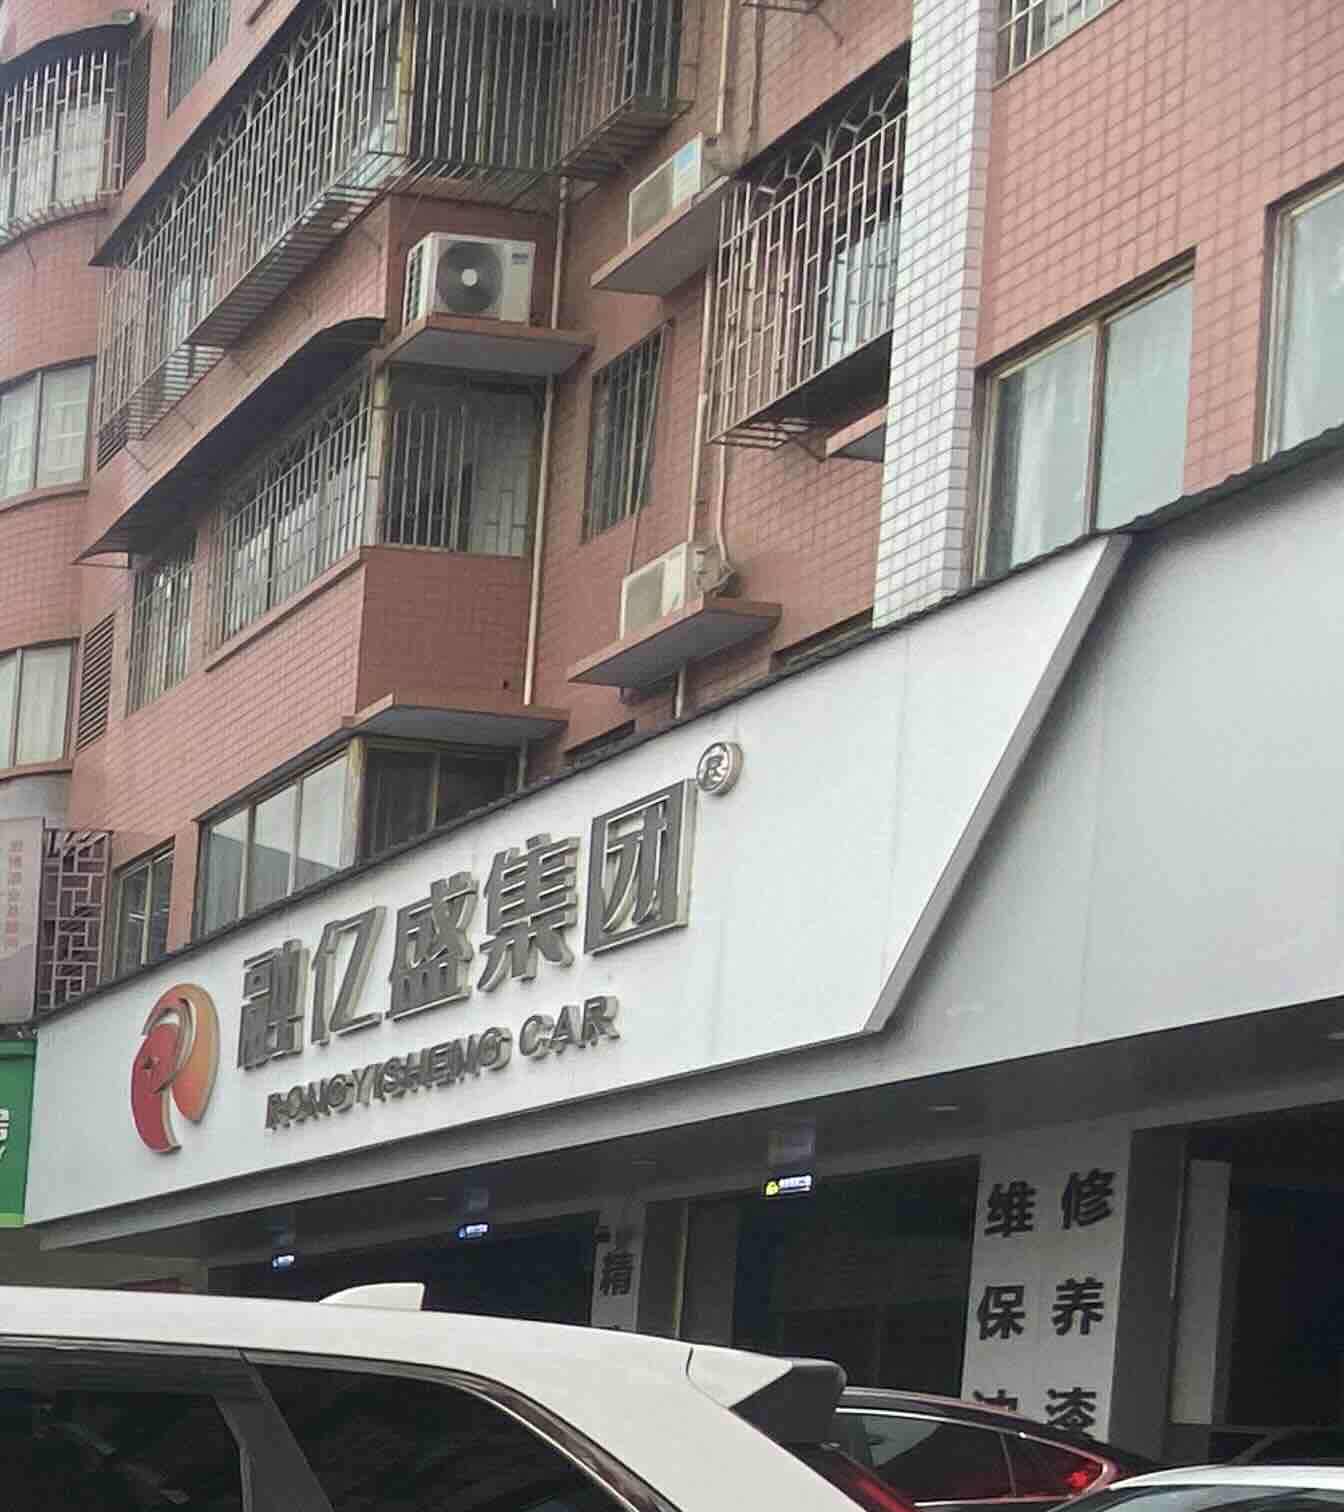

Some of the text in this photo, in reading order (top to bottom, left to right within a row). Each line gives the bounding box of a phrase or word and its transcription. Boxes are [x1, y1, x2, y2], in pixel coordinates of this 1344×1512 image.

[237, 778, 698, 1071] 融亿盛集团
[265, 995, 621, 1130] RONGYISHENG CAR
[984, 1168, 1116, 1238] 维修
[976, 1277, 1105, 1340] 保养
